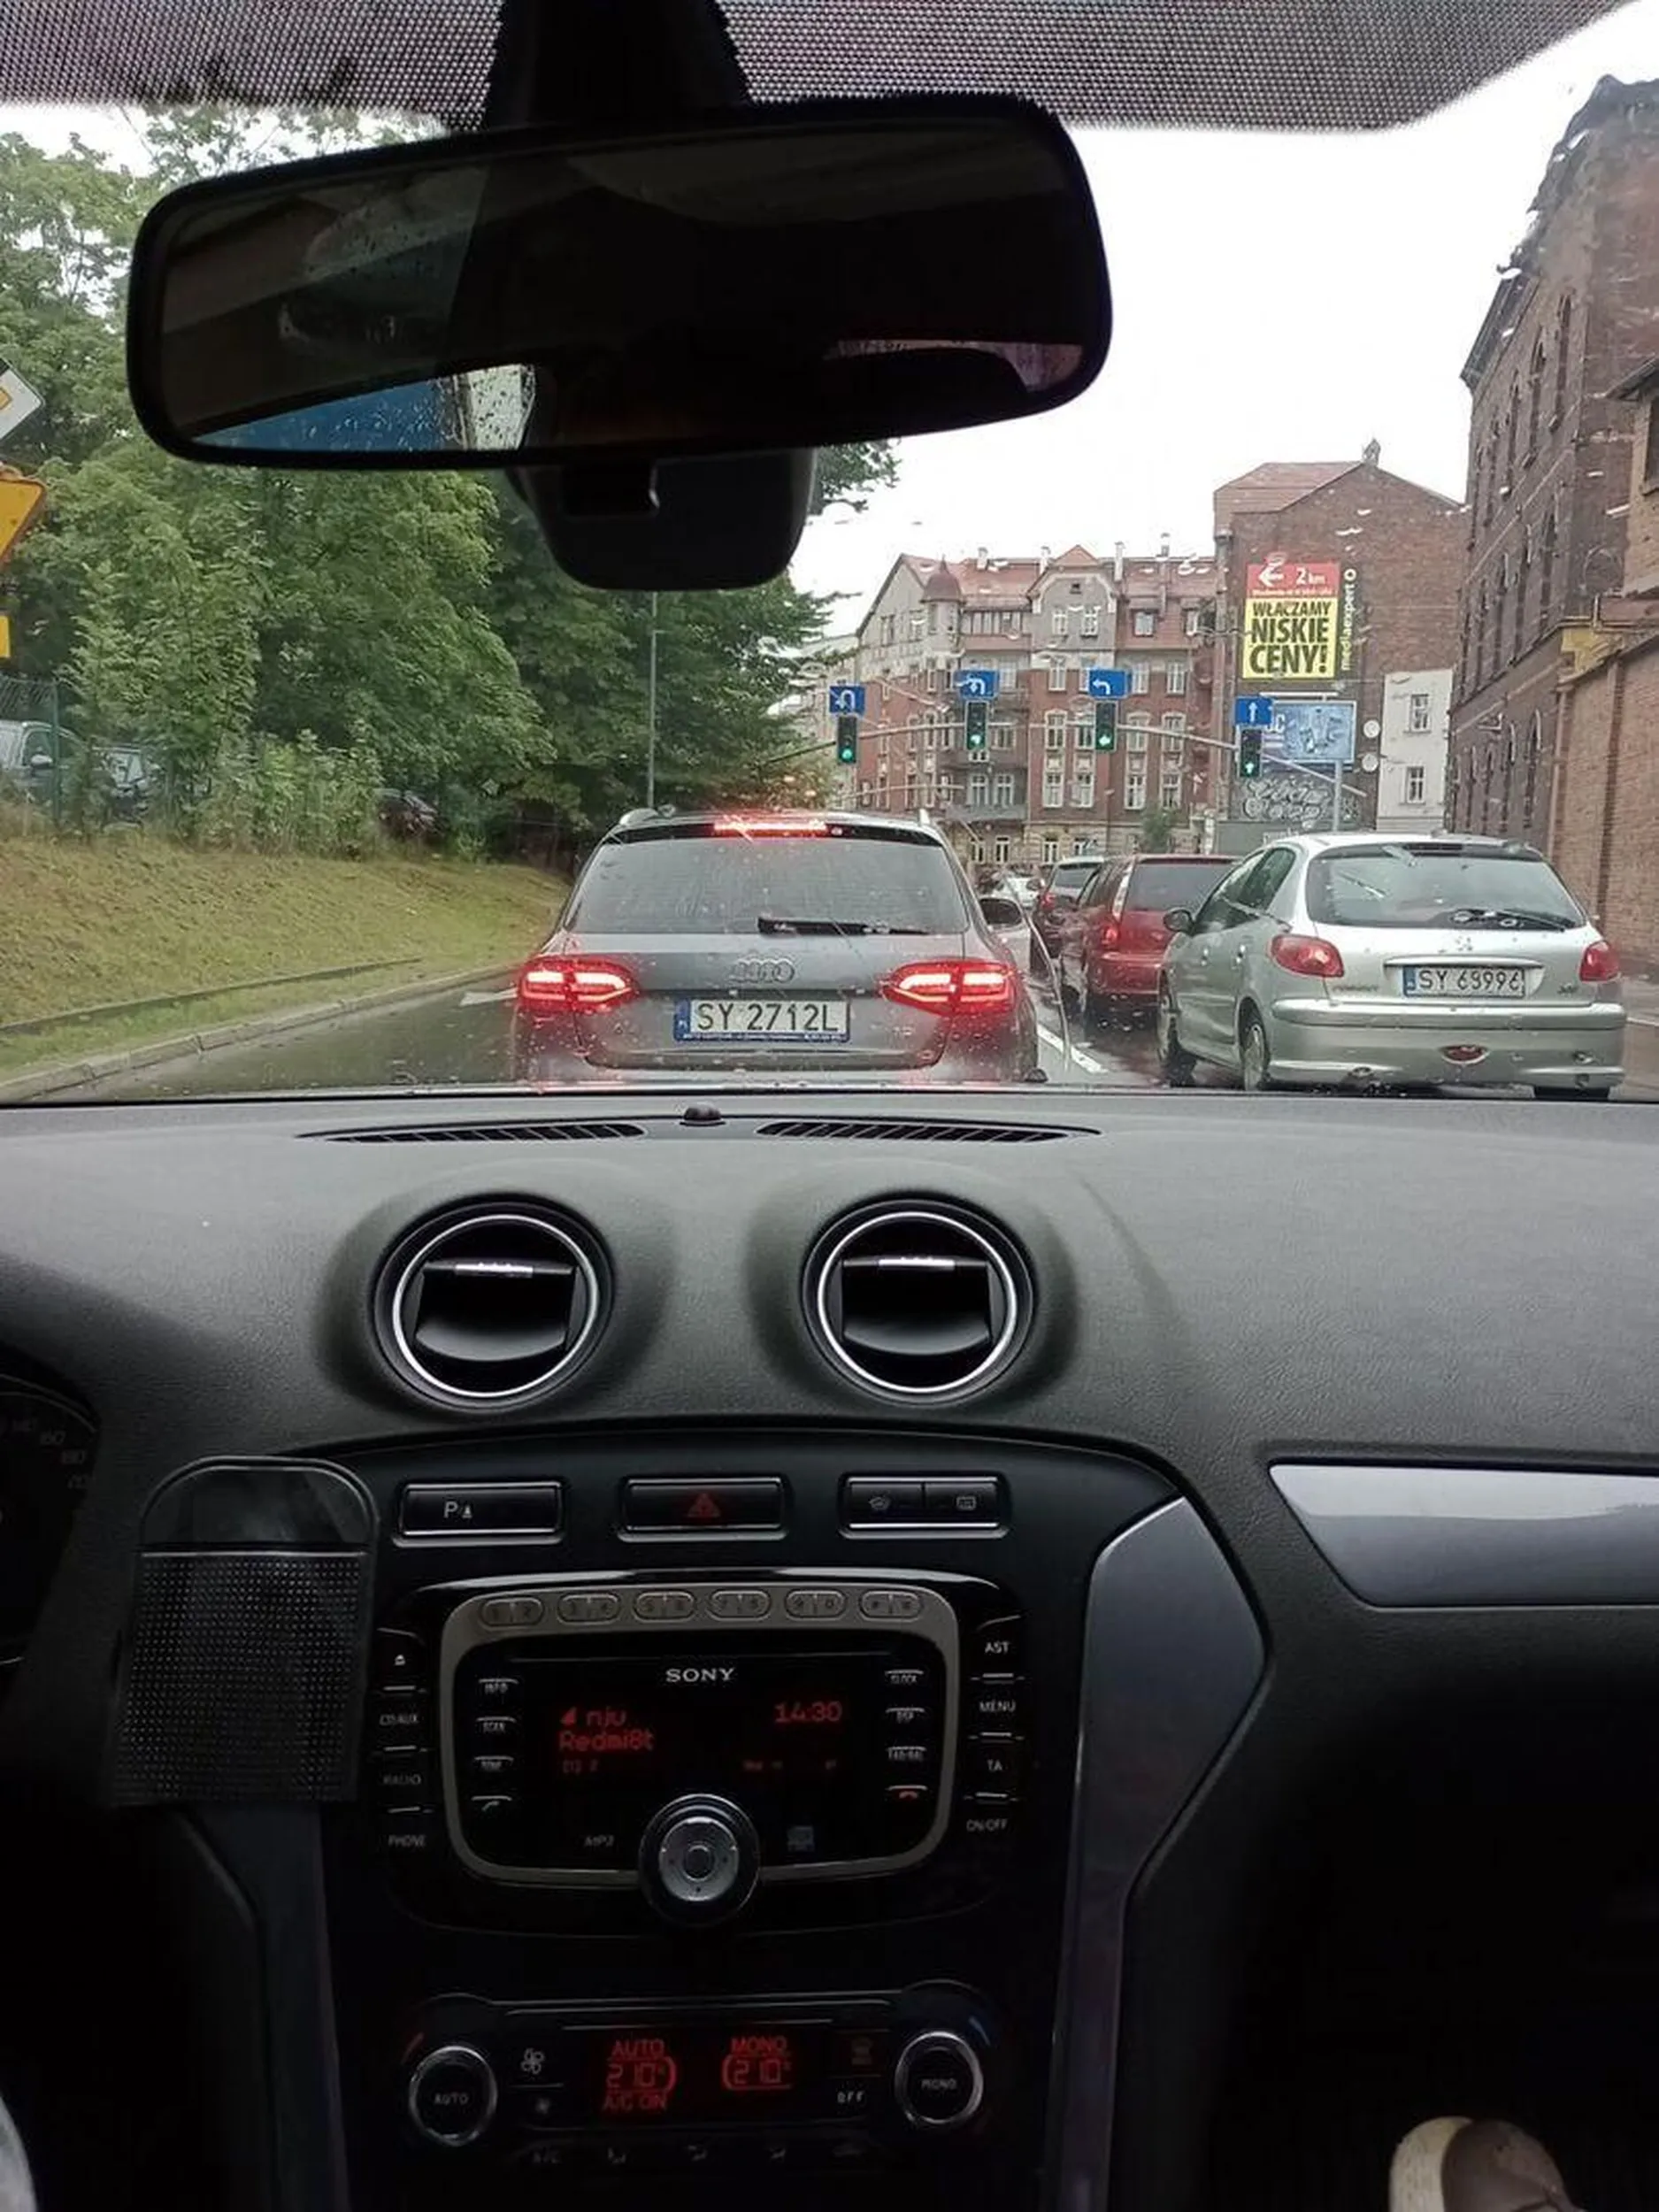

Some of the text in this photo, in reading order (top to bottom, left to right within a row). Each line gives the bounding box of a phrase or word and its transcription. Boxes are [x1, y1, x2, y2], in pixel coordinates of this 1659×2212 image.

[1295, 567, 1308, 585] 2
[1251, 618, 1330, 643] NISKIE
[1249, 645, 1327, 673] CENY!
[1418, 970, 1449, 990] SY
[697, 1003, 839, 1032] SY 2712L
[985, 1642, 1010, 1655] AST
[665, 1668, 735, 1682] SONY
[773, 1701, 842, 1723] 14:30
[979, 1700, 1017, 1713] MENU
[611, 2039, 664, 2057] AUTO
[730, 2035, 787, 2054] MONO
